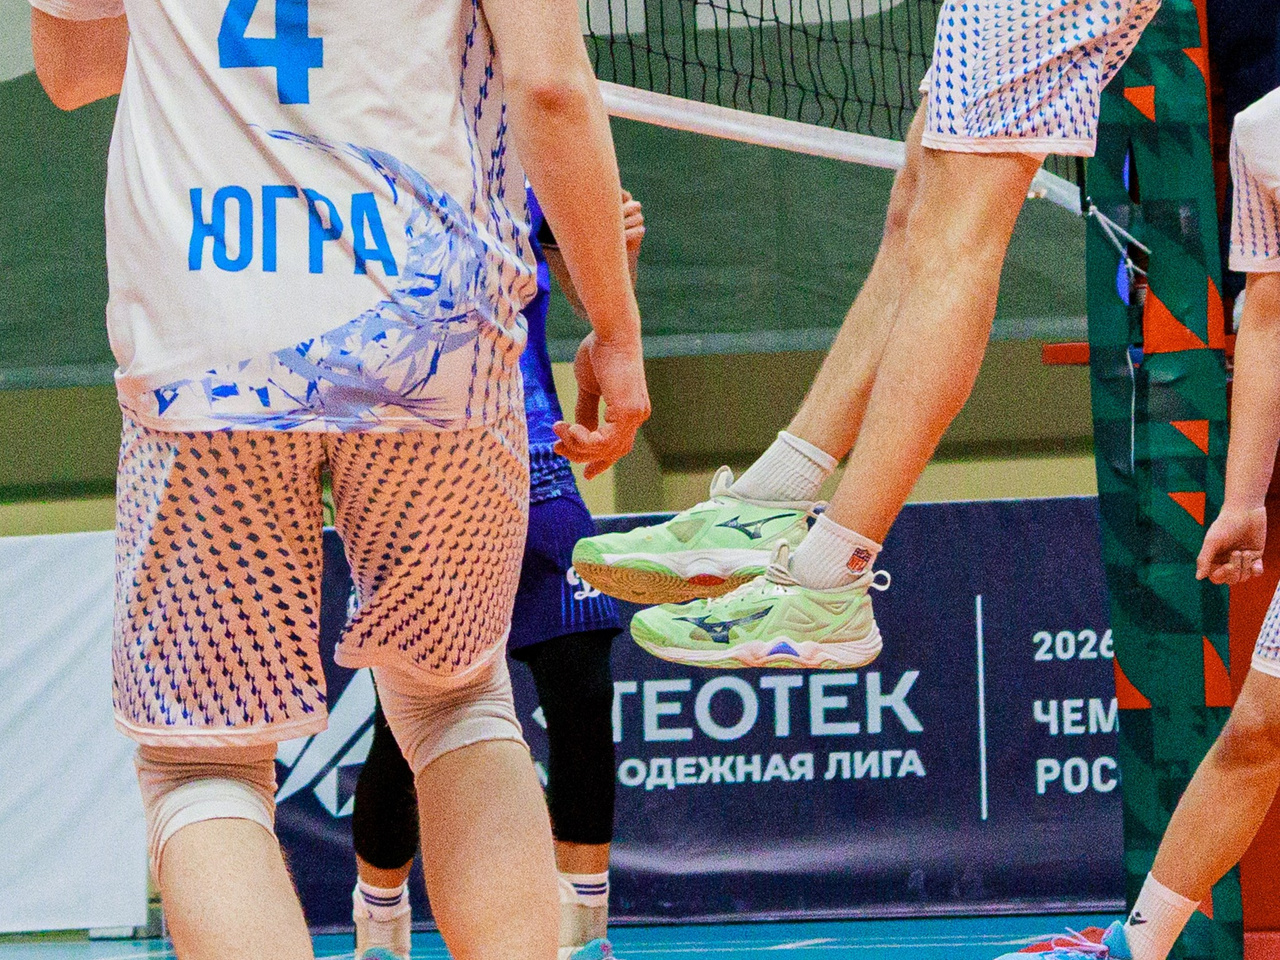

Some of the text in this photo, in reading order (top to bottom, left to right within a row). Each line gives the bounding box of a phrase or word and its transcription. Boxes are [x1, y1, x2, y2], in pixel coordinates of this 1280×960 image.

[188, 184, 399, 276] ЮГРА
[612, 669, 924, 743] ГЕОТЕК
[618, 749, 926, 791] ОДЕЖНАЯ ЛИГА
